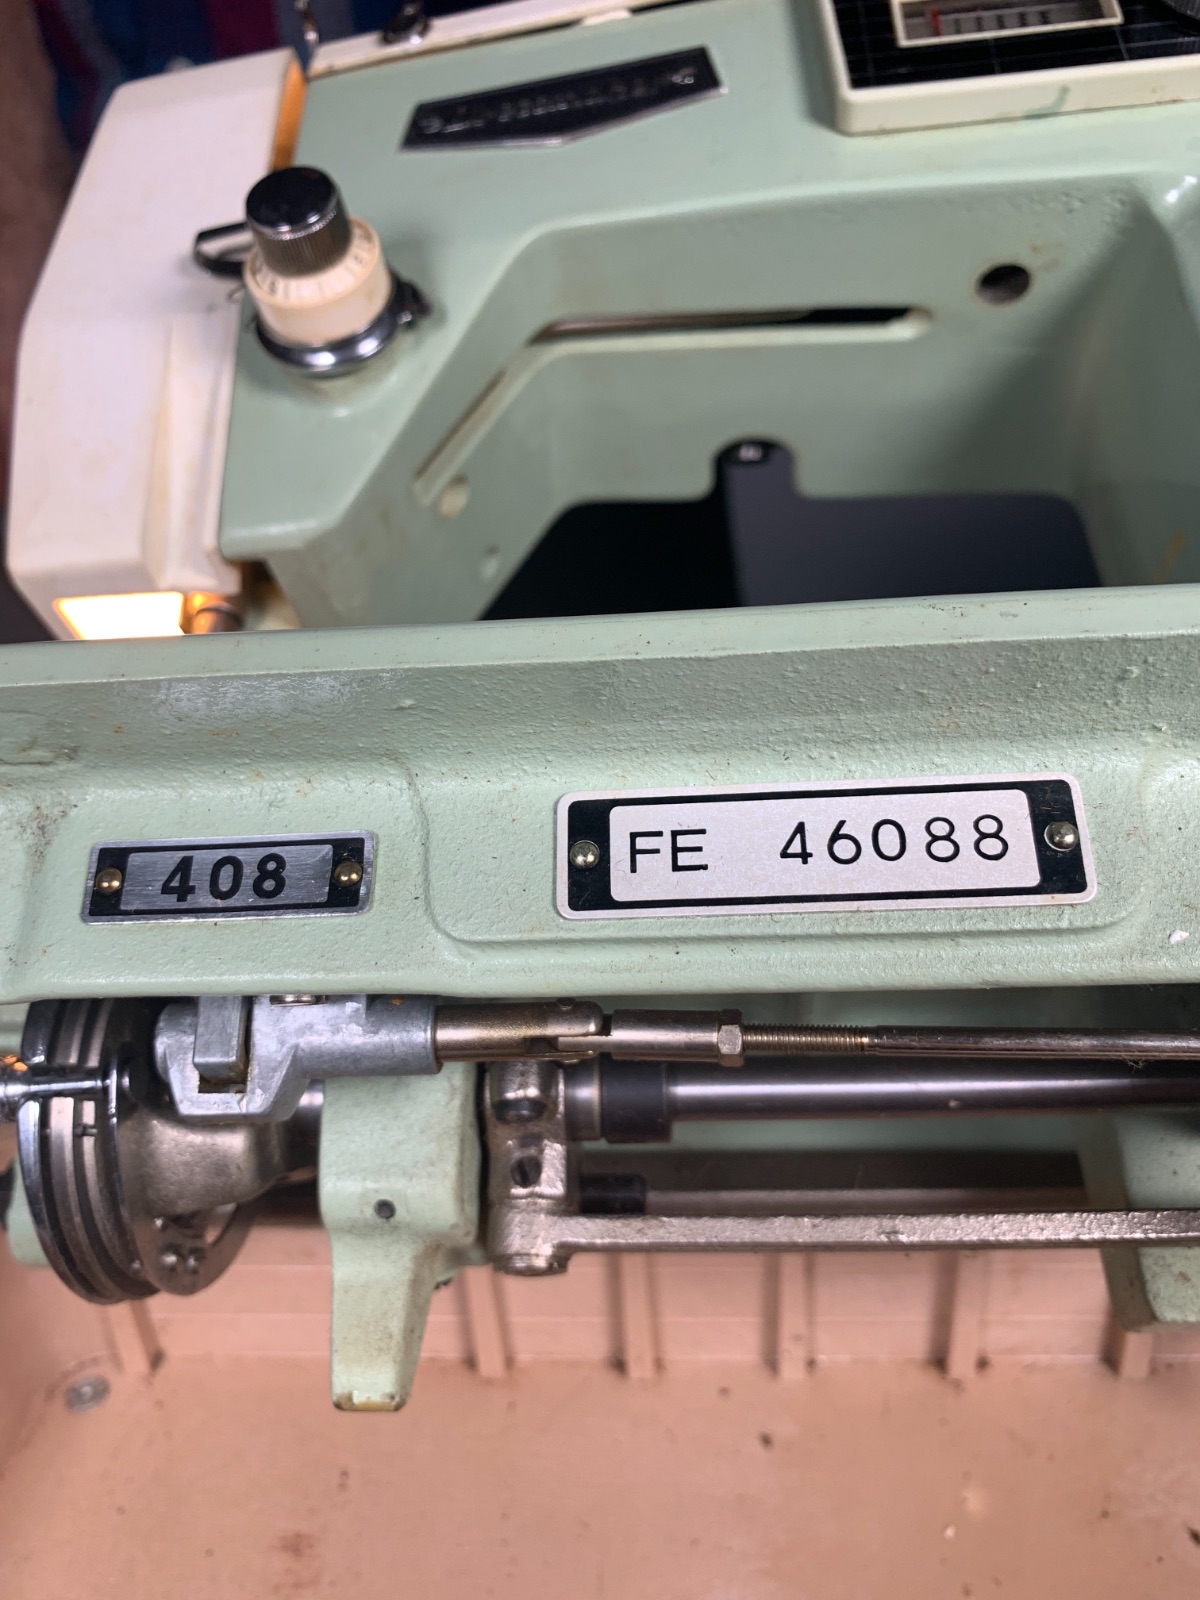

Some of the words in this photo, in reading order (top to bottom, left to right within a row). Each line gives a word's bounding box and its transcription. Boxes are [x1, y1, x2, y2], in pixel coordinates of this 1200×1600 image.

[629, 828, 709, 874] FE
[779, 814, 1009, 865] 46088
[160, 852, 287, 903] 408
